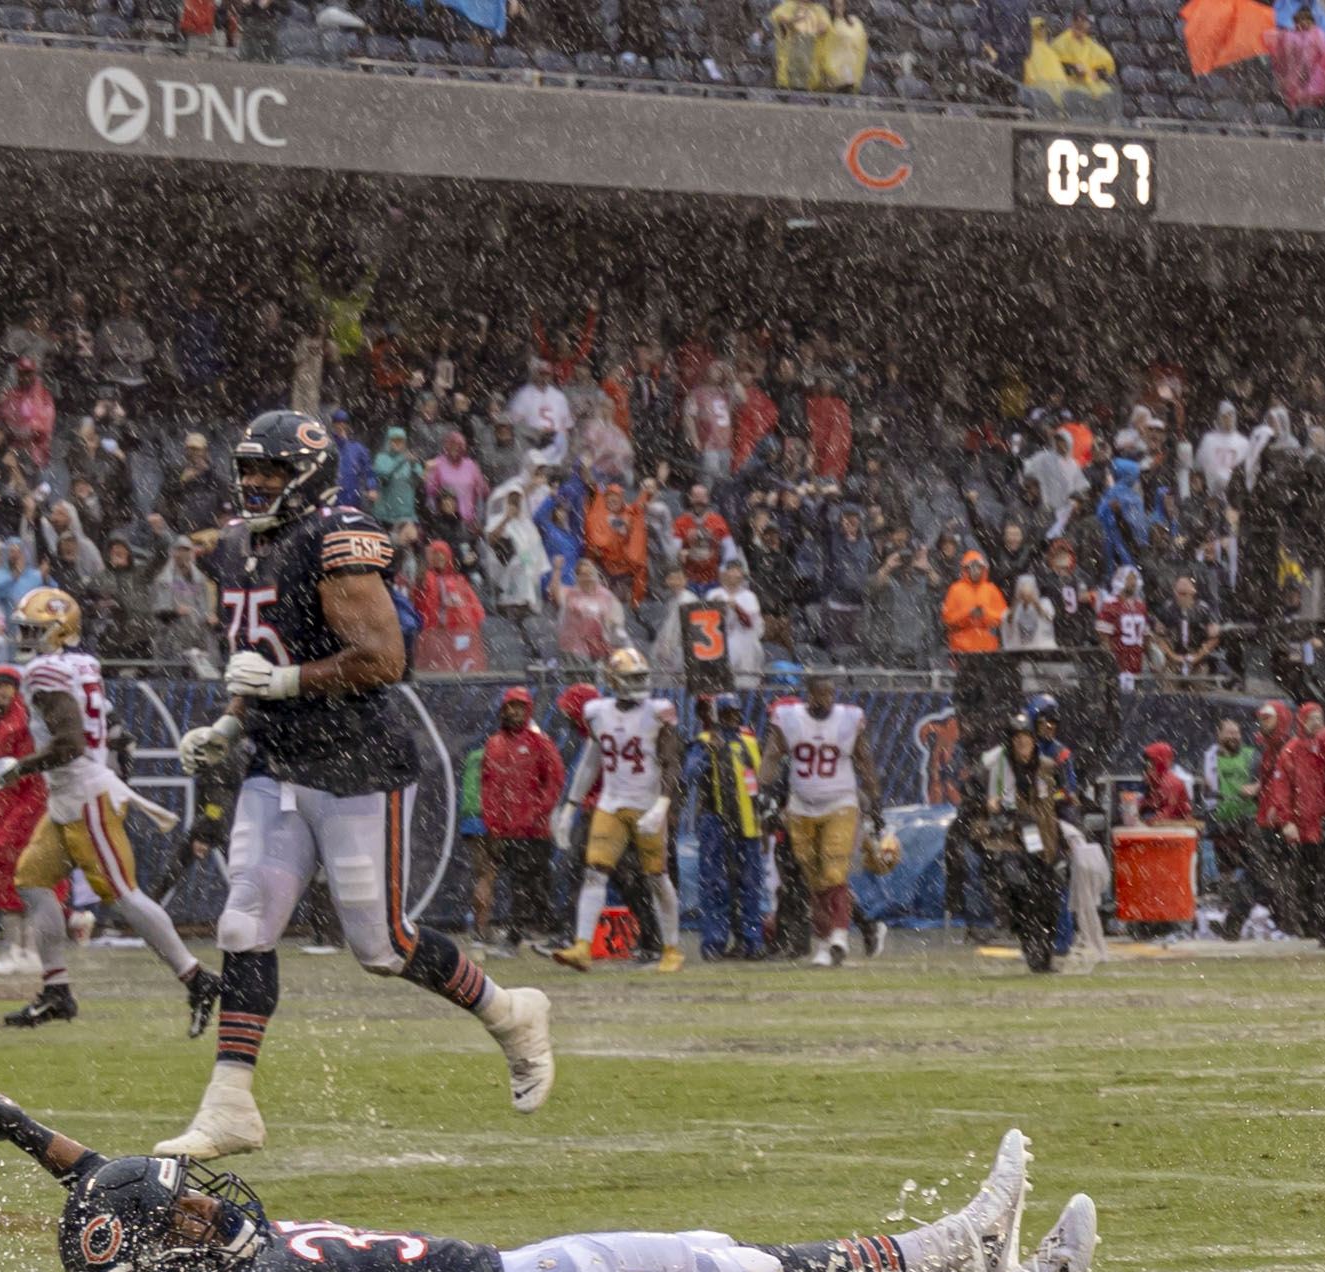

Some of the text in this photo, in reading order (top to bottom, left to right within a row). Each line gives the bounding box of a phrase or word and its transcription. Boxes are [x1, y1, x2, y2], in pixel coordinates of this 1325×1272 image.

[157, 80, 288, 147] PNC
[1047, 139, 1150, 209] 0:27
[349, 539, 381, 558] GSH
[223, 585, 293, 667] 75
[689, 609, 725, 661] 3
[599, 734, 646, 775] 94
[794, 742, 841, 779] 98
